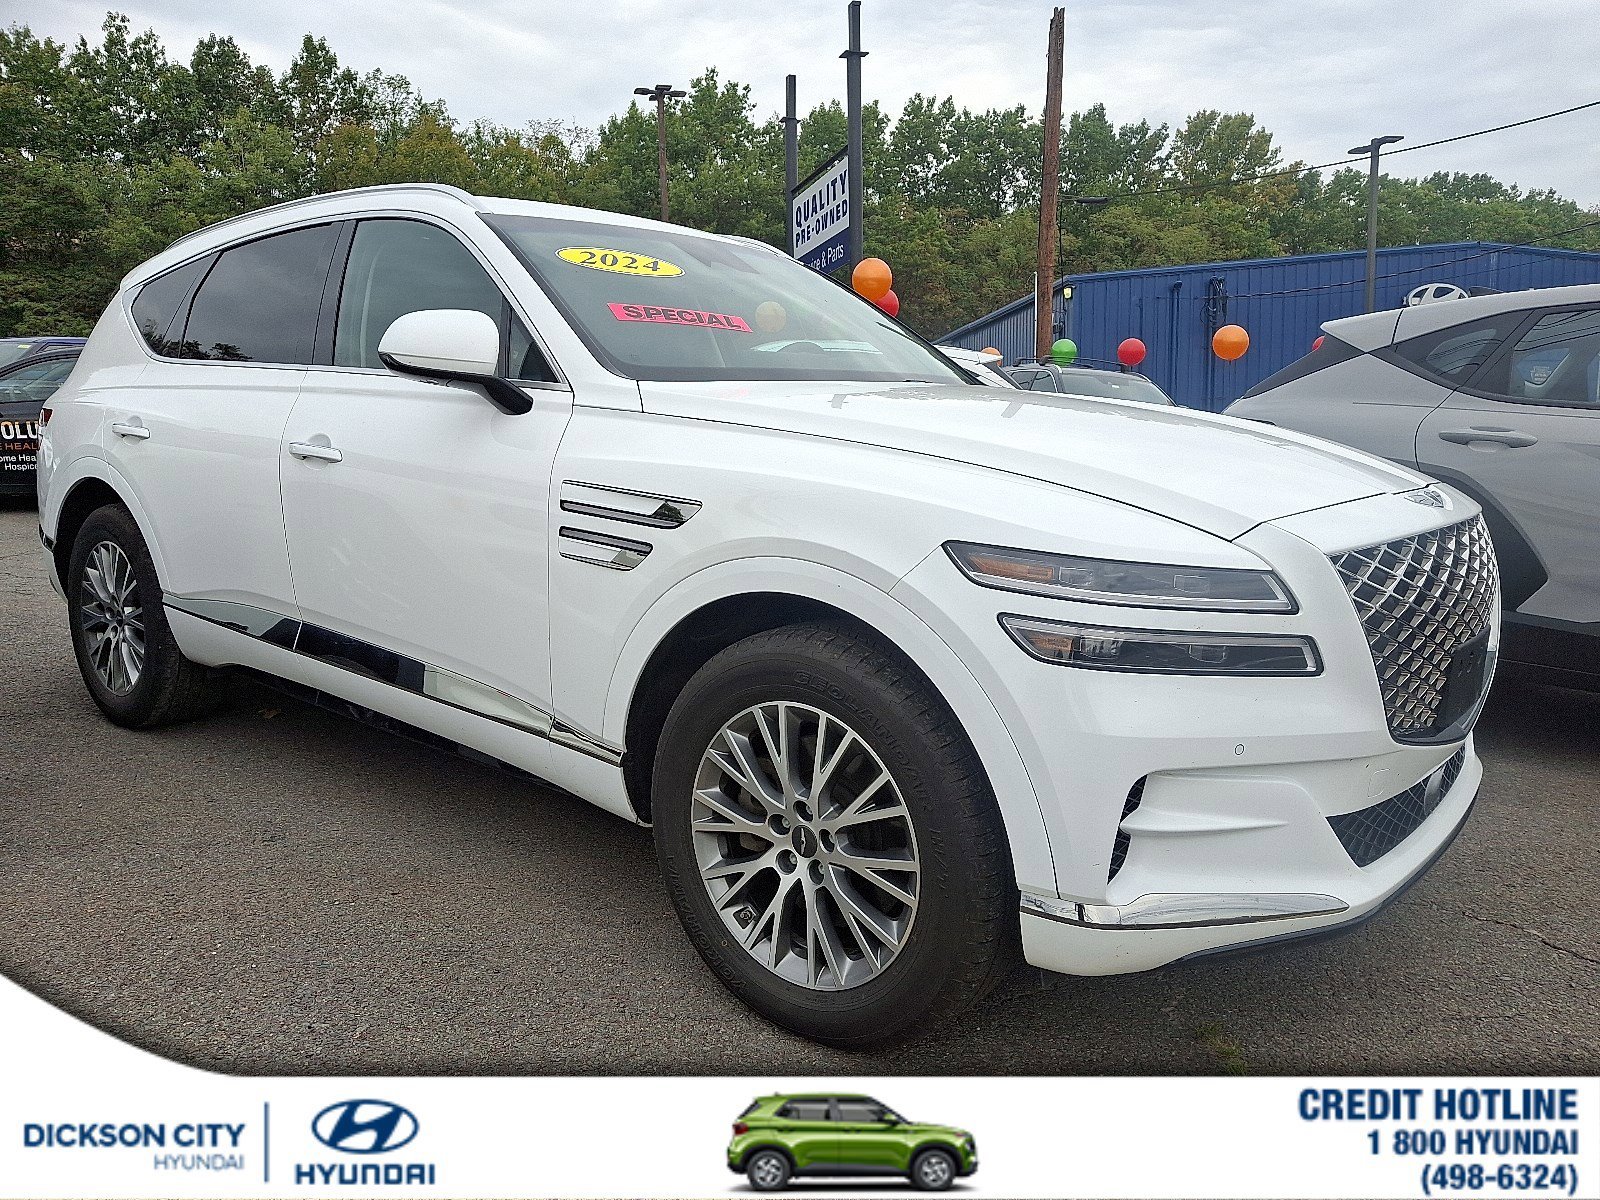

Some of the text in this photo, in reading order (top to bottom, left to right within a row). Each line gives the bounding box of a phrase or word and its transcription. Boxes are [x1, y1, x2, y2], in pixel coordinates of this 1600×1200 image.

[795, 168, 848, 229] QUALITY
[795, 199, 848, 249] PRE-OWNED
[579, 250, 661, 272] 2024
[821, 250, 827, 268] &
[827, 243, 844, 265] Parts
[622, 304, 742, 330] SPECIAL
